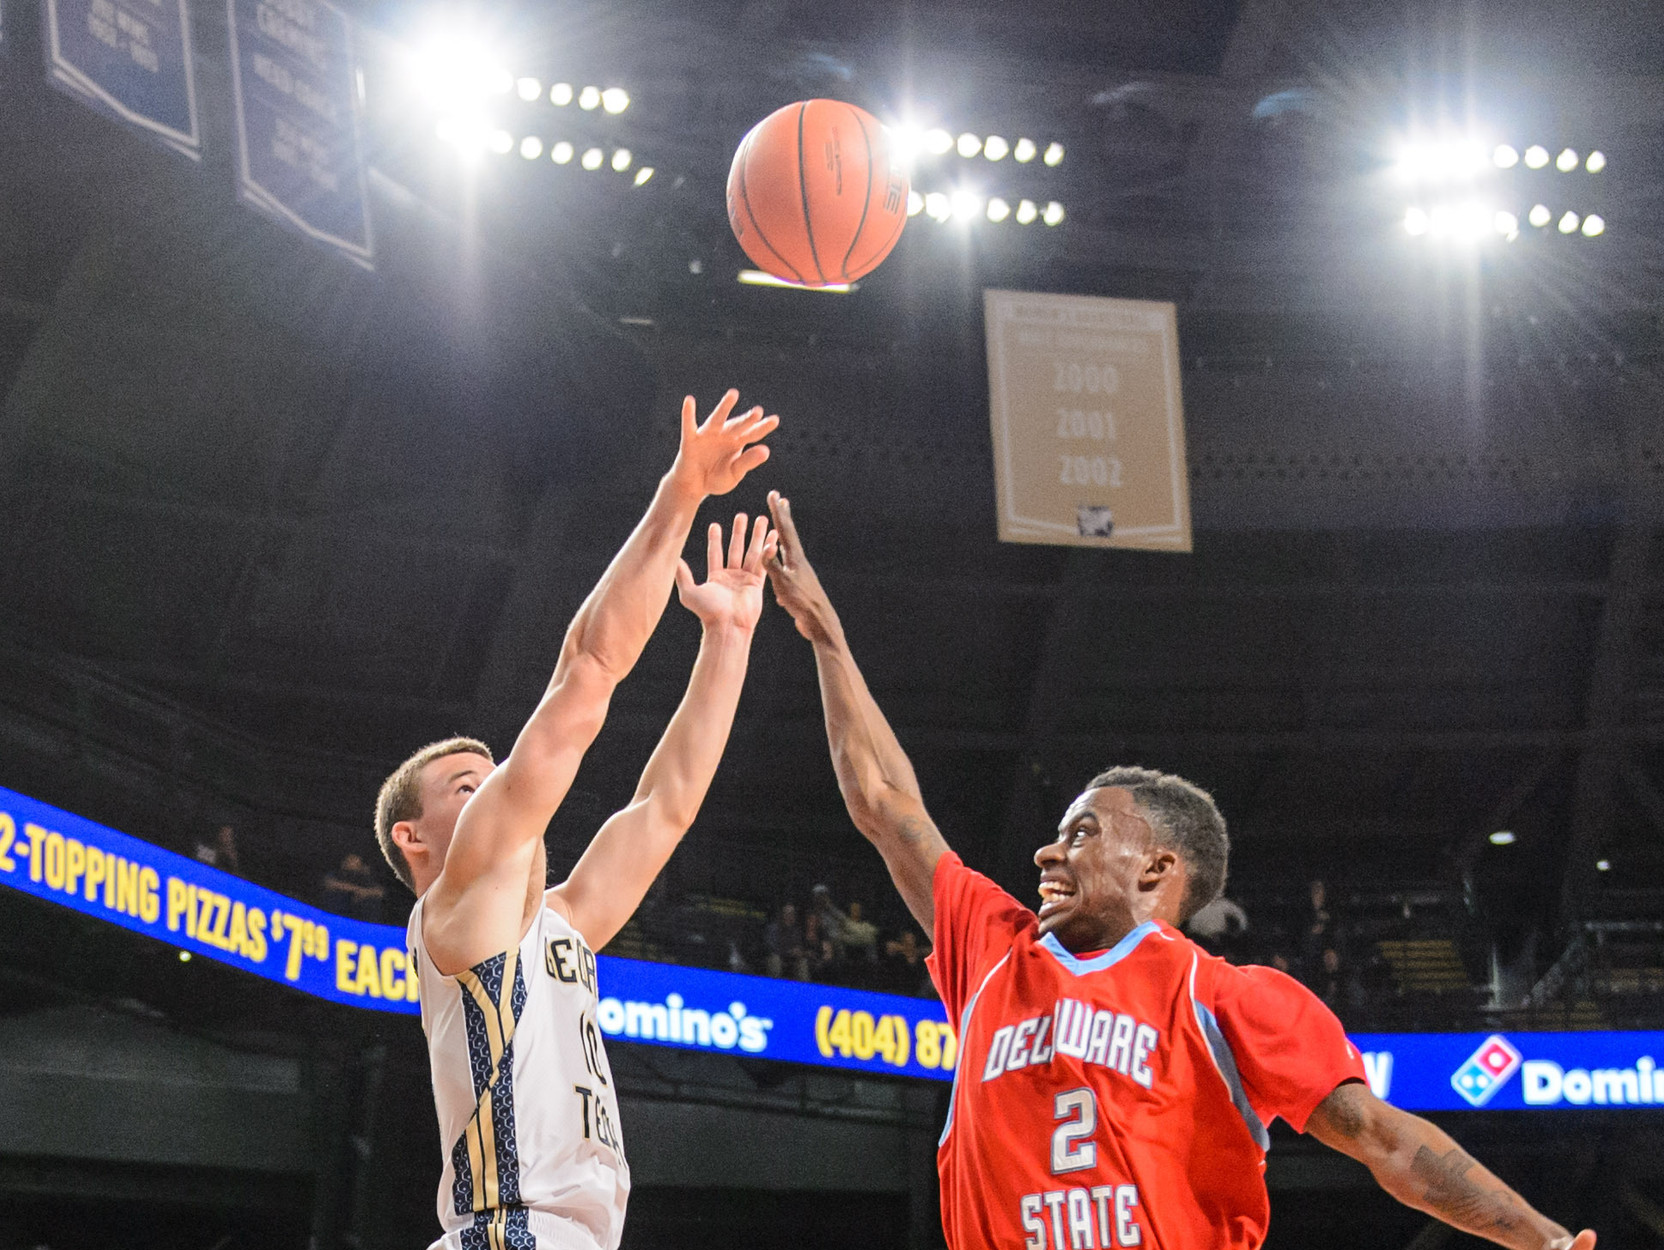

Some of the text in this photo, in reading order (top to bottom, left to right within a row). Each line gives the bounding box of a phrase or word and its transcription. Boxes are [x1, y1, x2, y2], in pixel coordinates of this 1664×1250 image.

[1053, 362, 1119, 394] 2000
[1056, 407, 1117, 440] 2001
[1060, 454, 1123, 488] 2002
[0, 811, 160, 924] 2-TOPPING
[166, 876, 268, 963] PIZZAS
[597, 992, 773, 1053] omino's
[815, 1006, 911, 1067] (404)
[1051, 1086, 1098, 1175] 2
